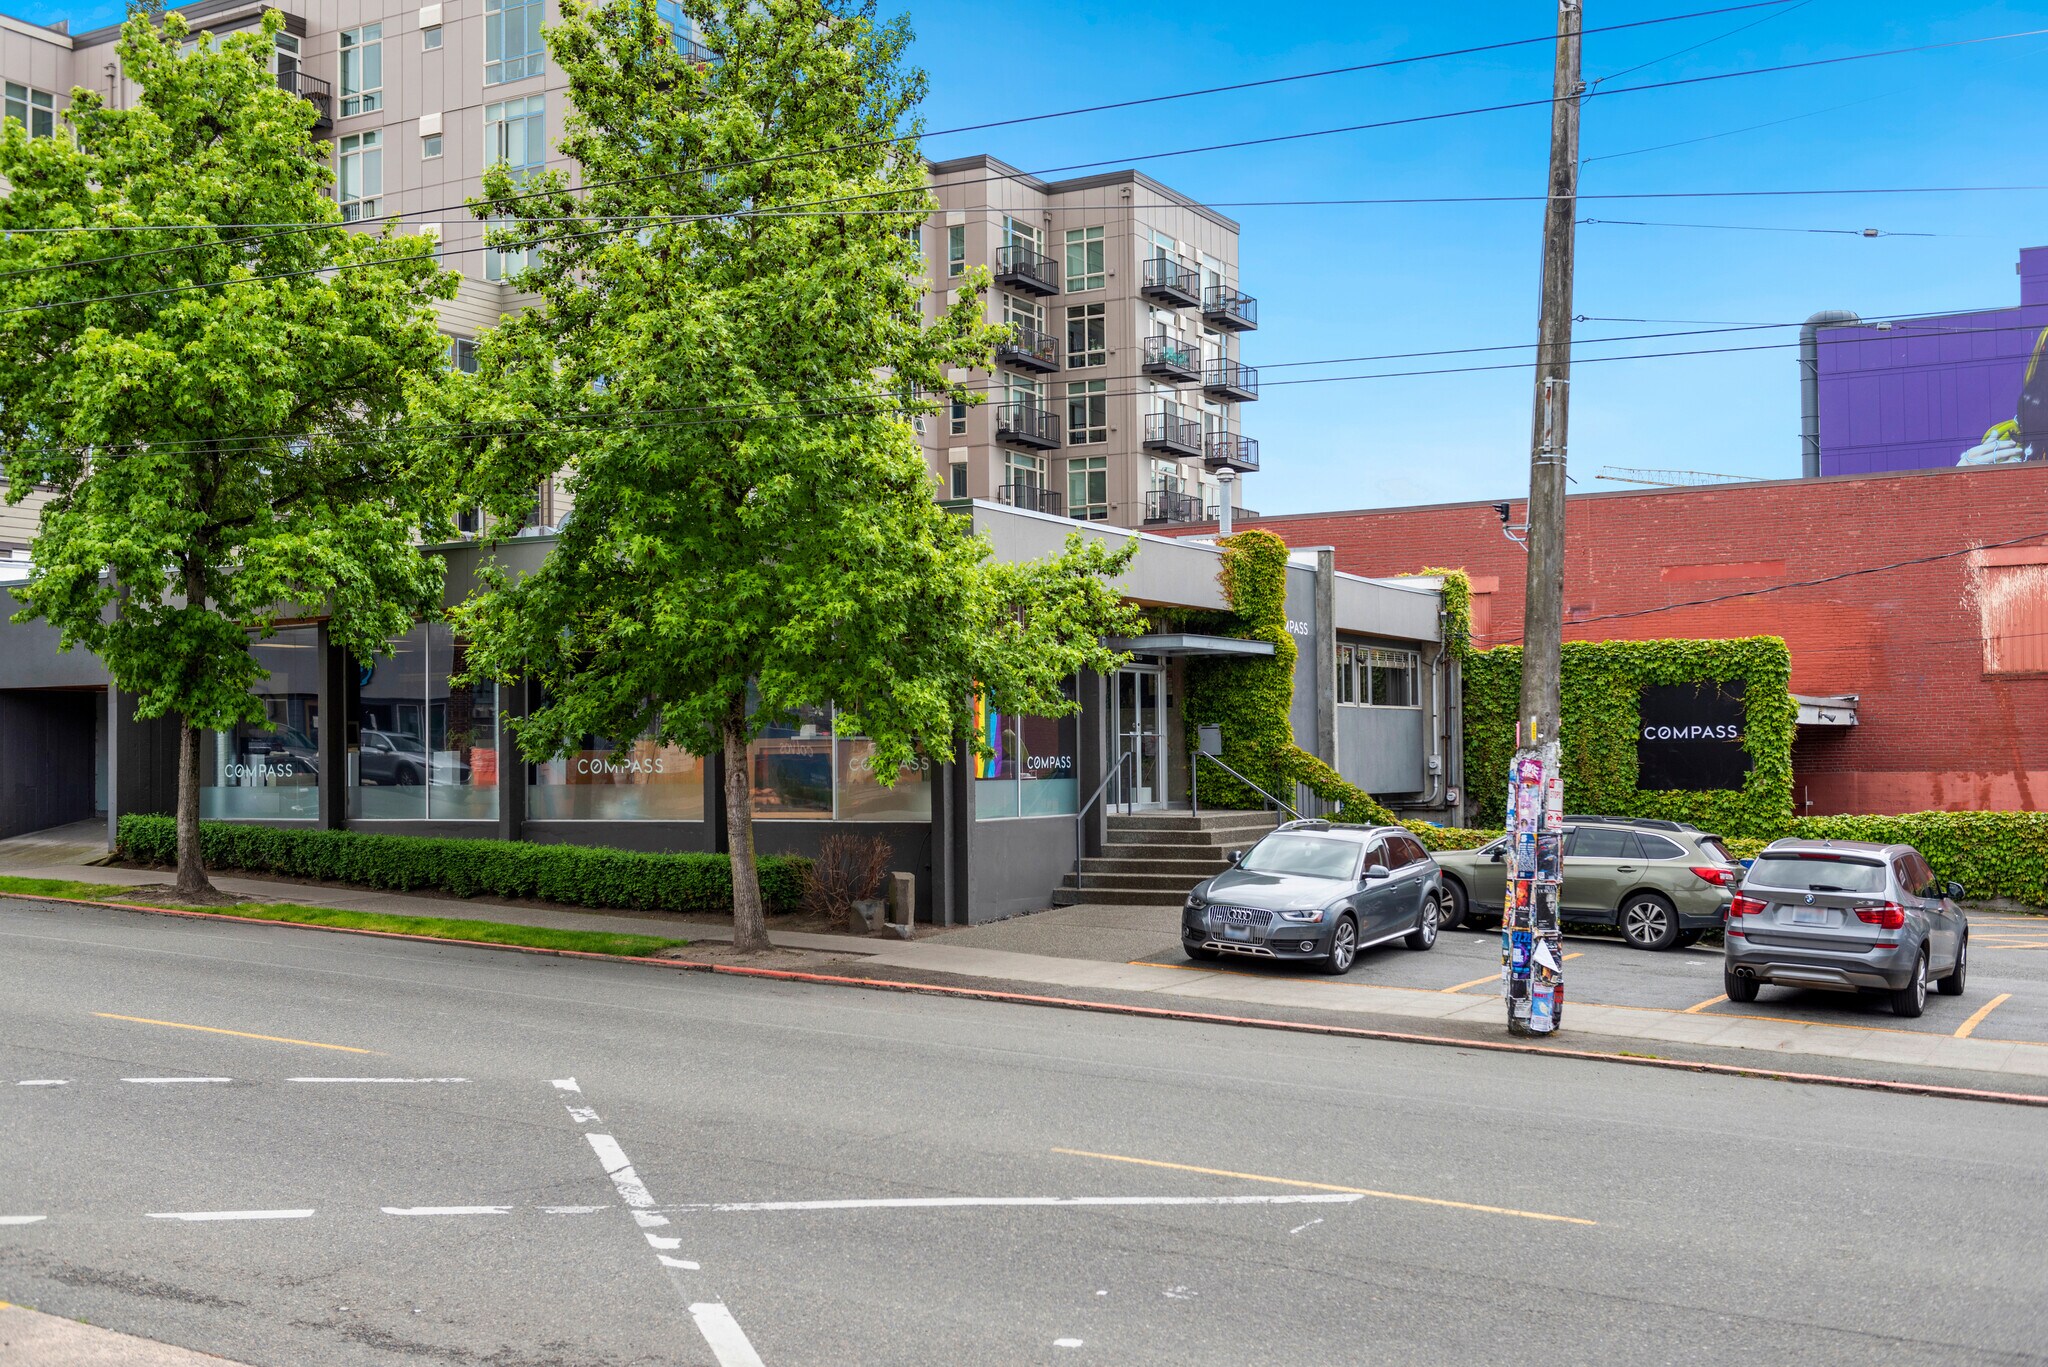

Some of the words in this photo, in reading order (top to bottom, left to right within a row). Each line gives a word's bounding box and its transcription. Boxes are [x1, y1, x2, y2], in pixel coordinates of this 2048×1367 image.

[1284, 620, 1309, 635] MPASS
[1644, 725, 1738, 740] COMPASS
[577, 758, 664, 774] COMPASS
[849, 757, 929, 771] COASS
[1027, 755, 1072, 769] COMPASS
[224, 763, 293, 778] COMPASS
